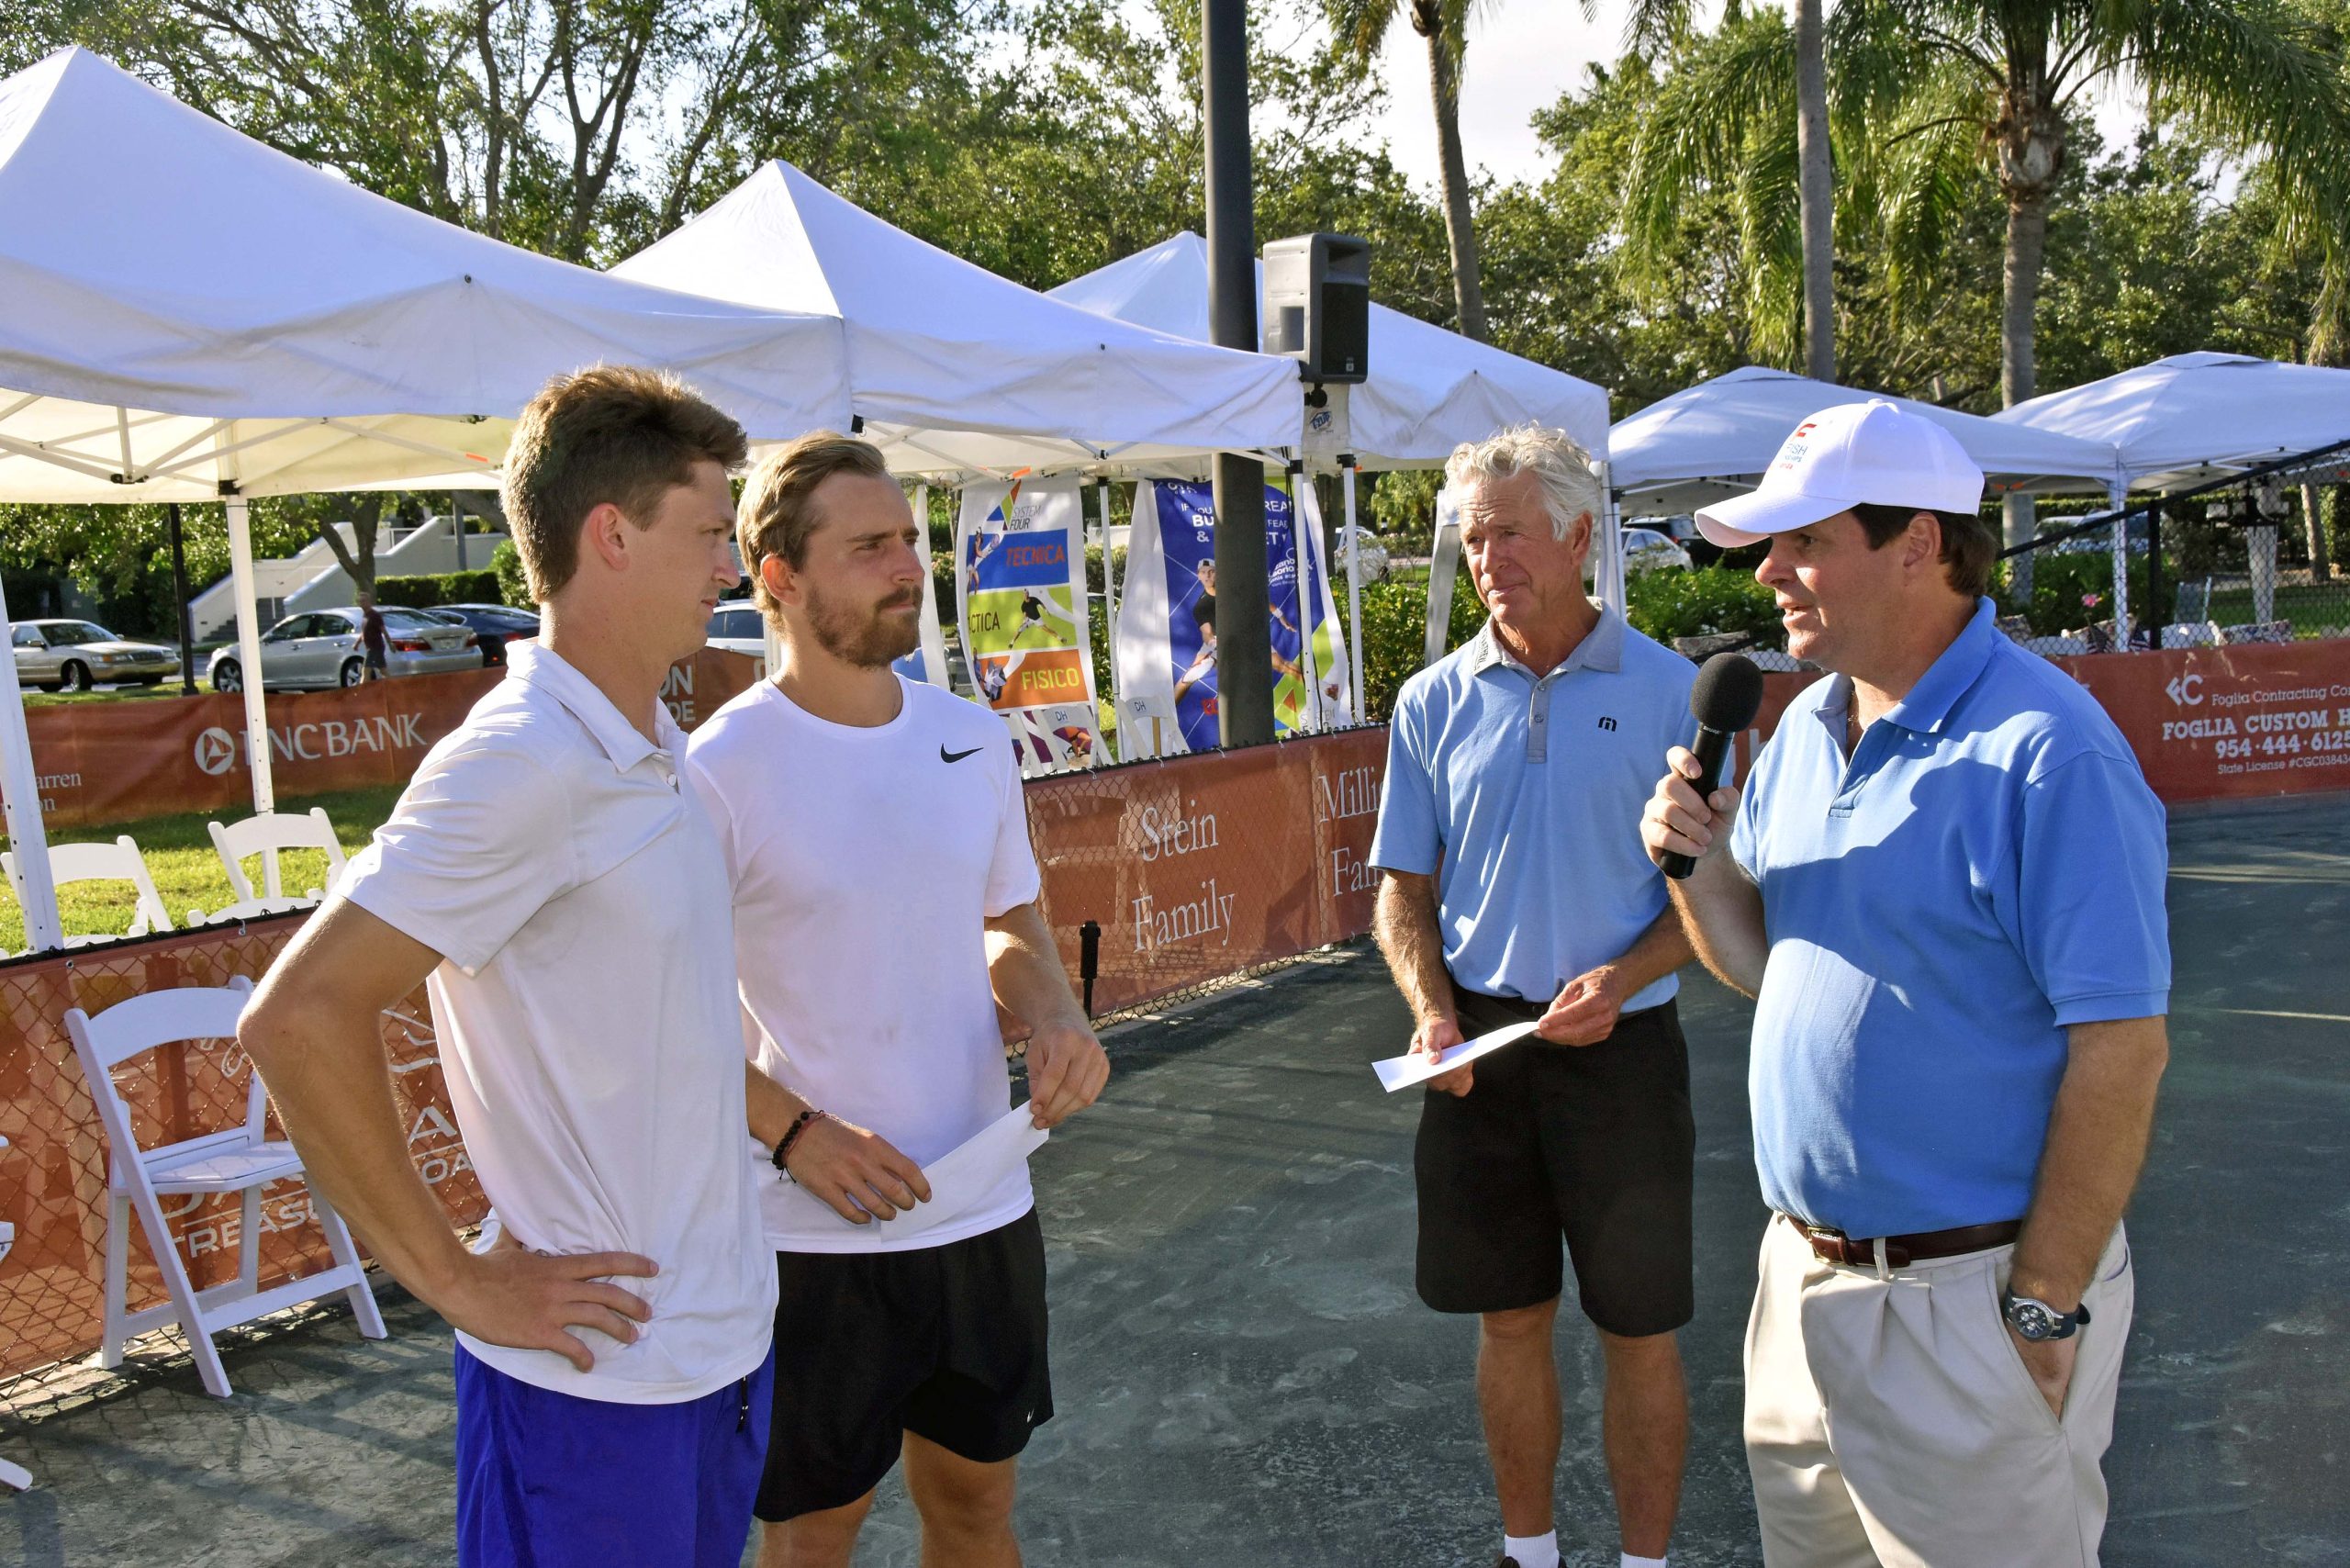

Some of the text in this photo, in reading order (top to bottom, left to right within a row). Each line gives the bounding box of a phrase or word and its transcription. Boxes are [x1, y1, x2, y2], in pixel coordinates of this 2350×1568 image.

[1013, 505, 1041, 519] SYSTEM
[1010, 517, 1030, 531] FOUR
[1196, 531, 1210, 543] &
[1006, 544, 1066, 567] TECNICA
[1021, 667, 1080, 691] FISICO
[2212, 685, 2350, 708] Foglia Contracting Co
[2162, 718, 2237, 741] FOGLIA
[2245, 710, 2329, 734] CUSTOM
[2218, 762, 2244, 775] State
[2246, 760, 2286, 773] License
[36, 773, 82, 790] arren
[1318, 766, 1384, 823] Milli
[1141, 801, 1219, 861] Stein
[1131, 878, 1235, 954] Family
